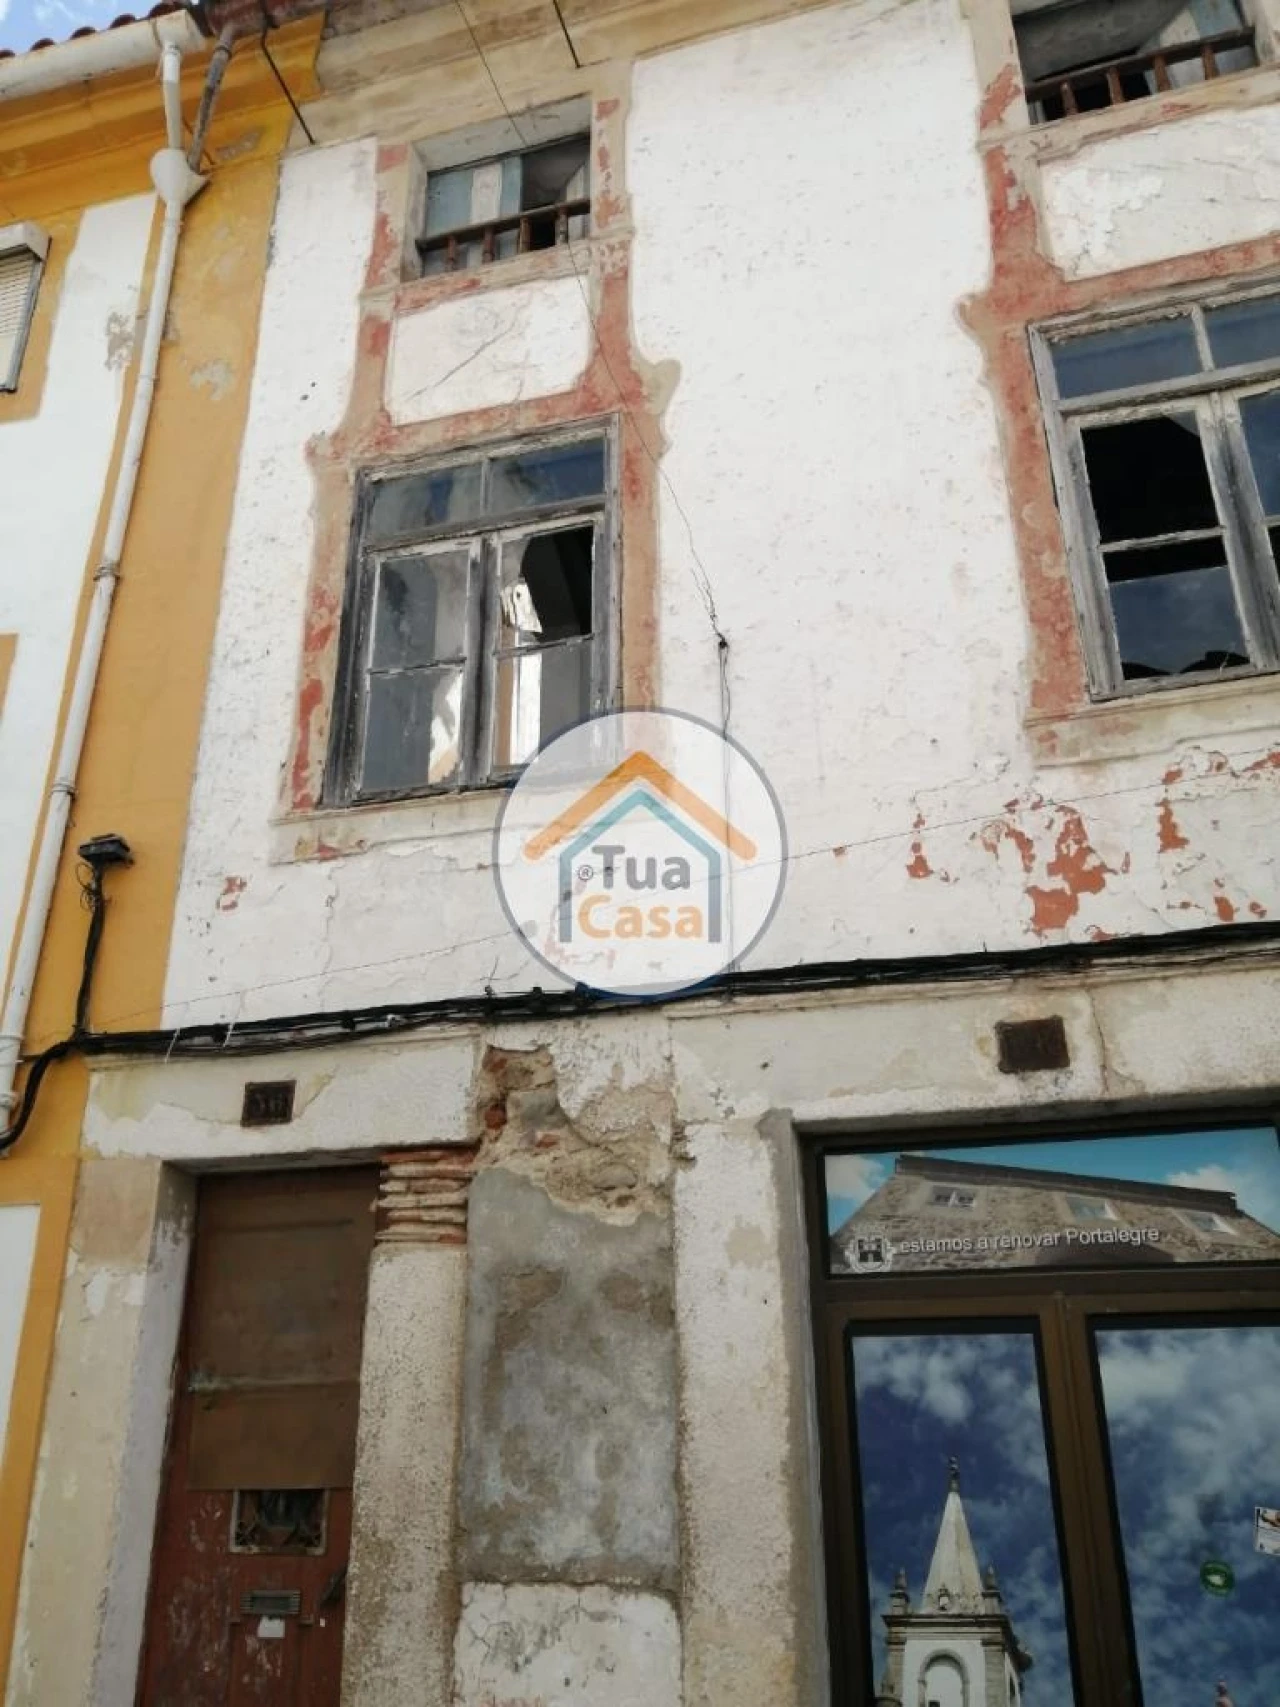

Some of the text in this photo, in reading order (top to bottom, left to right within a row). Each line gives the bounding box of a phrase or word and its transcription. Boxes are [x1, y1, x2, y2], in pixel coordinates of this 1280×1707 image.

[901, 1227, 1160, 1253] estamos a renovar Portalegre
